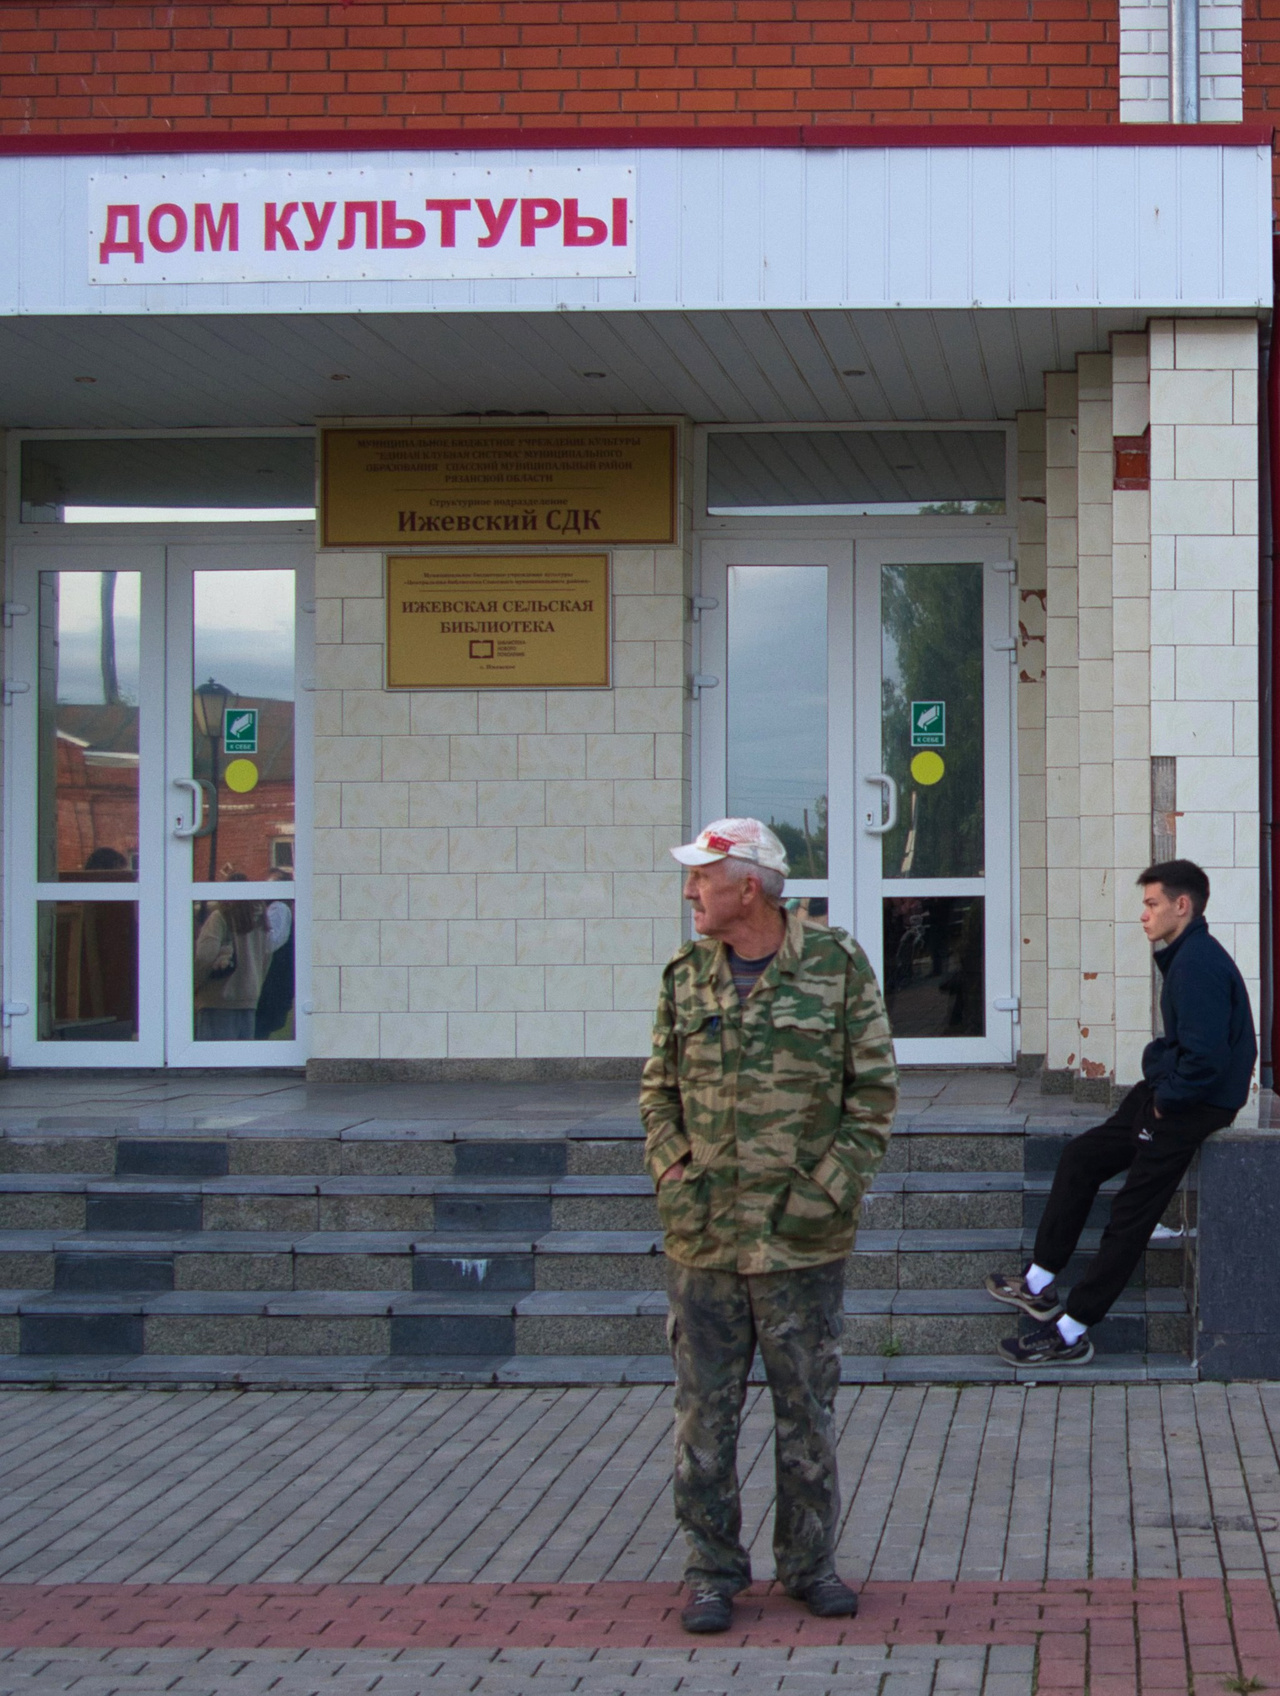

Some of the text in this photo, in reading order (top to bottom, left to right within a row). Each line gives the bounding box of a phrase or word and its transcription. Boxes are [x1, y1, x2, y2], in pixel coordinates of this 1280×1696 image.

[100, 197, 629, 264] ДОМ КУЛЬТУРЫ
[444, 473, 554, 483] РЯЗАНСКОЙ ОБЛАСТИ
[429, 498, 569, 508] Структурное подразделение
[397, 508, 602, 535] Ижевский СДК
[401, 599, 594, 613] ИЖЕВСКАЯ СЕЛЬСКАЯ
[440, 621, 555, 634] БИБЛИОТЕКА
